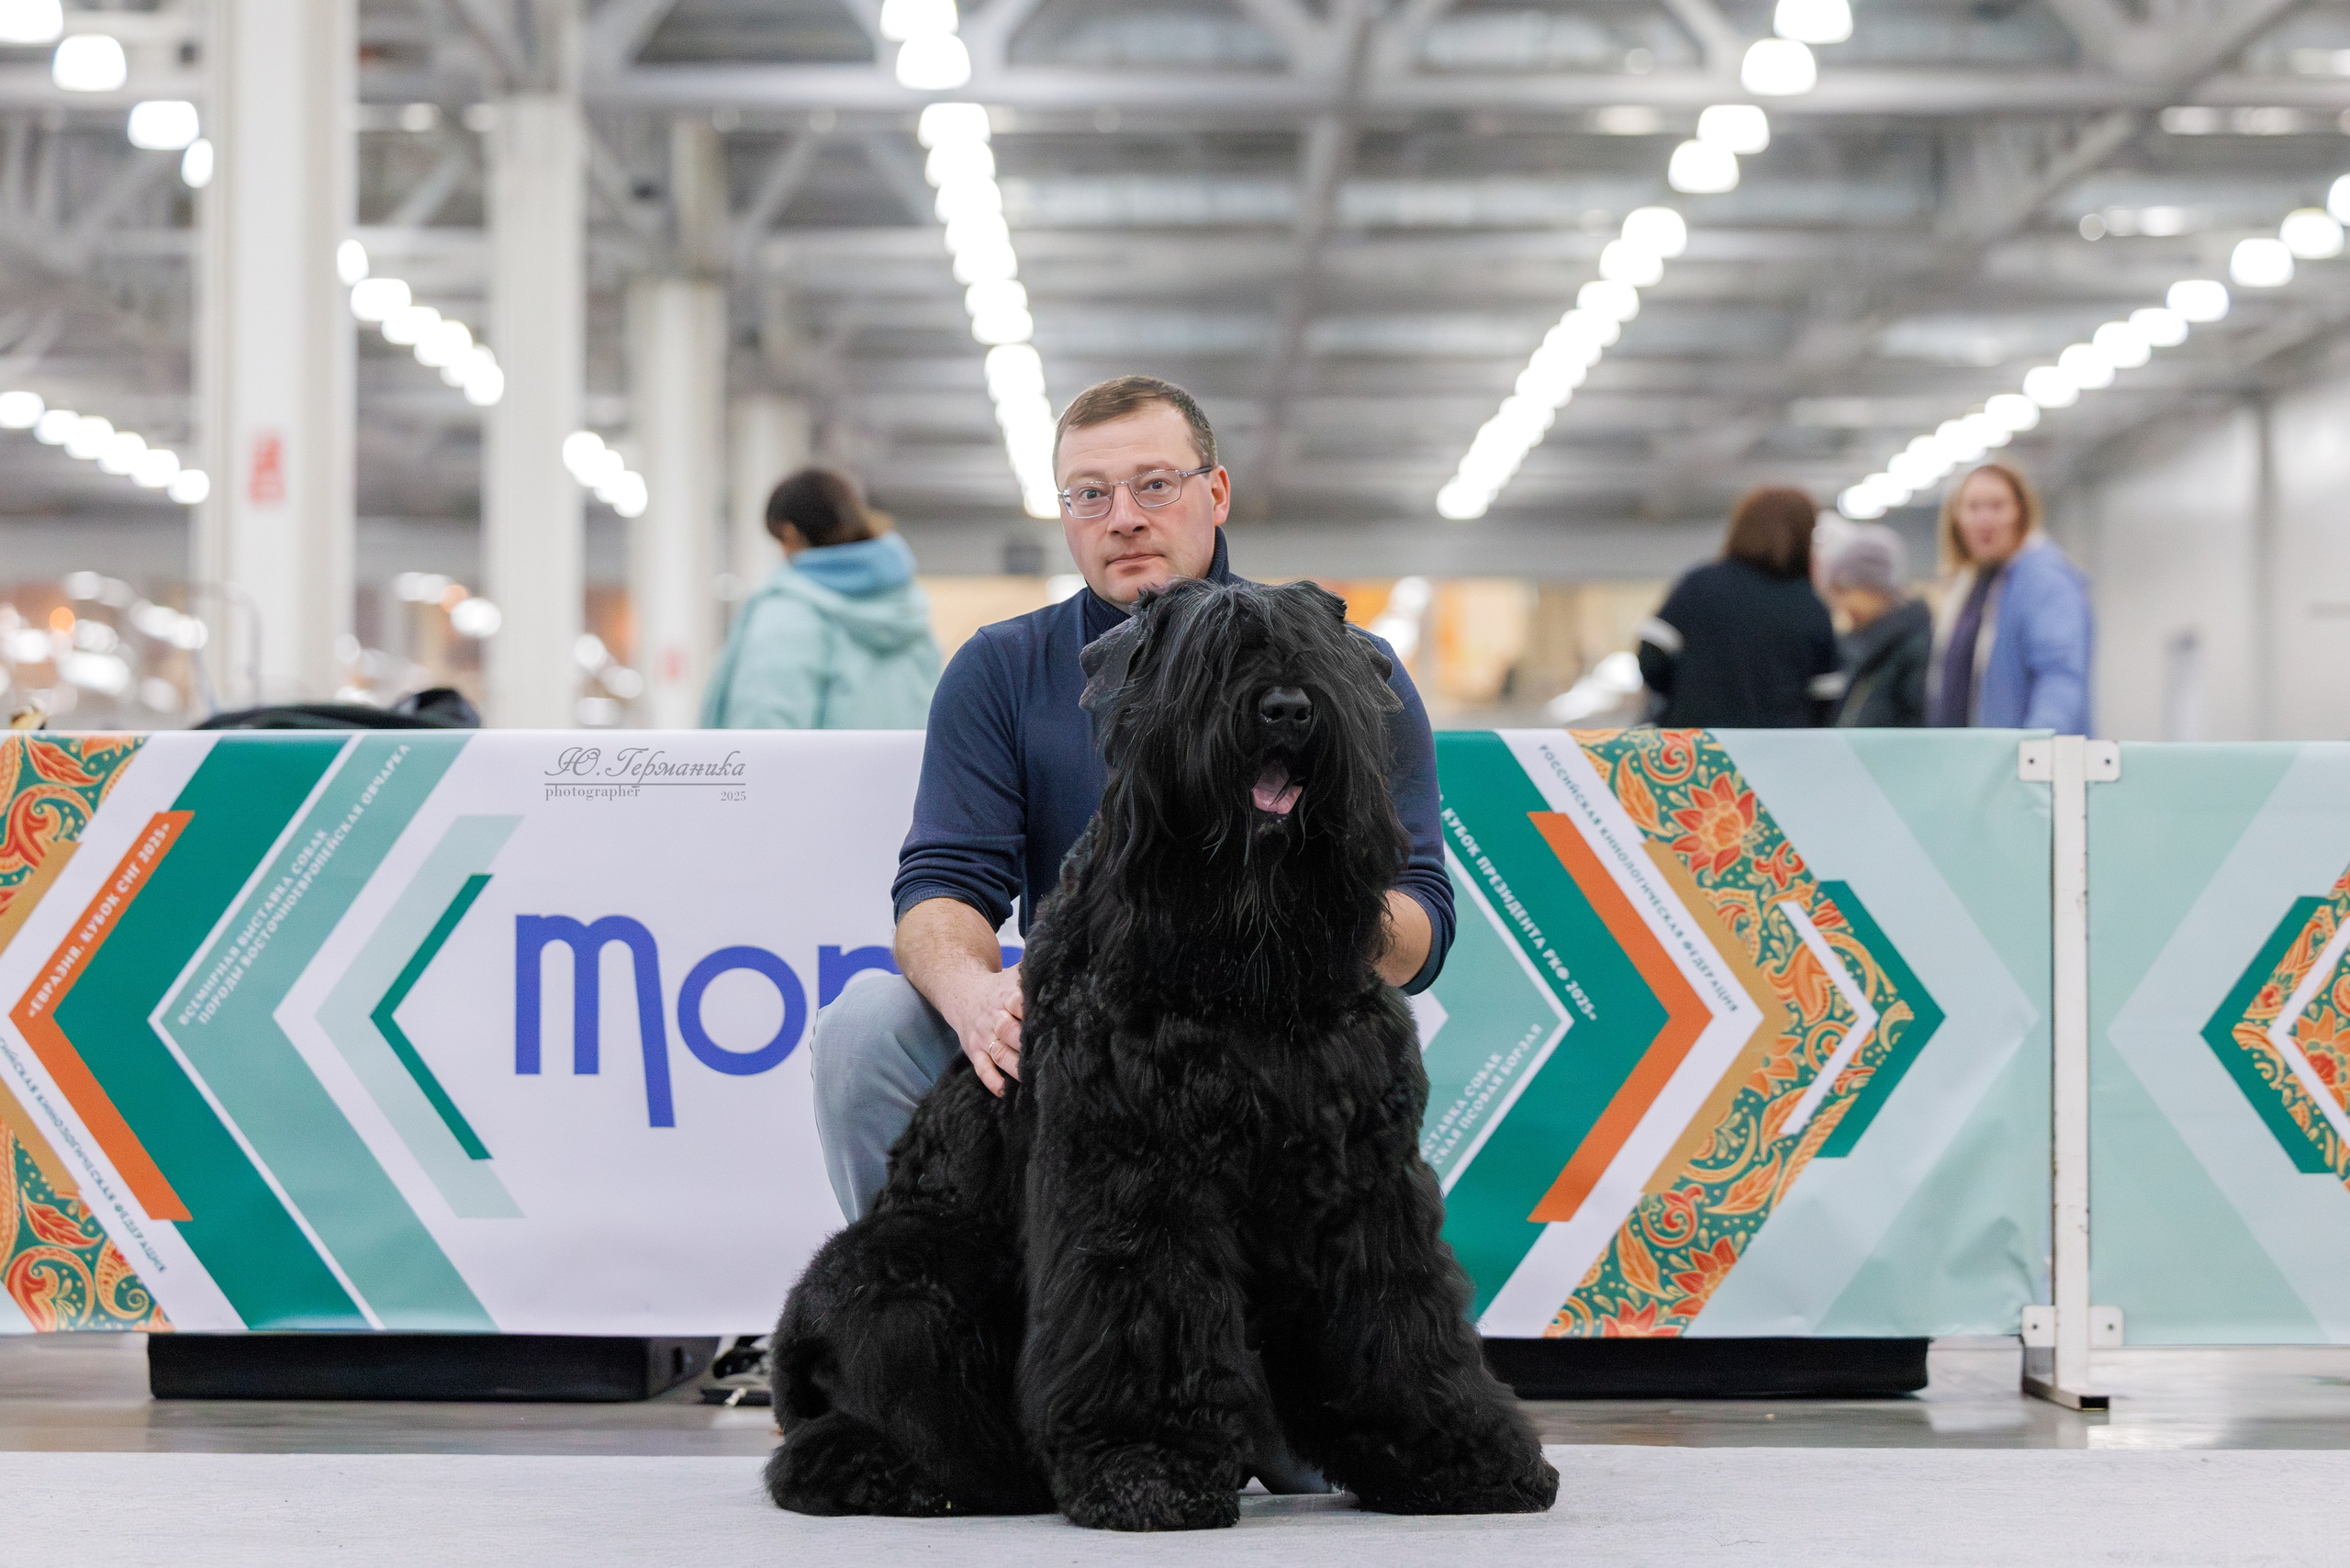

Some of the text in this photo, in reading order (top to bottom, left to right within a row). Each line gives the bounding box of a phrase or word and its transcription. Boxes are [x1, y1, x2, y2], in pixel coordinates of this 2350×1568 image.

[79, 892, 120, 943] КУБОК
[116, 861, 140, 893] СНГ
[178, 828, 328, 1026] ВСЕМИРНАЯ ВЫСТАВКА СОБАК
[197, 744, 411, 1025] ПОРОДЫ ВОСТОЧНОЕВРОПЕЙСКАЯ ОВЧАРКА
[1441, 807, 1482, 857] КУБОК
[1475, 856, 1547, 950] ПРЕЗИДЕНТА
[1542, 948, 1570, 980] РКФ
[1538, 744, 1738, 1012] РОССИЙСКАЯ КИНОЛОГИЧЕСКАЯ ФЕДЕРАЦИЯ
[1458, 1074, 1505, 1129] ПСОВАЯ
[1499, 1024, 1543, 1075] БОРЗАЯ
[1463, 1052, 1503, 1097] СОБАК
[35, 1093, 116, 1202] КИНОЛОГИЧЕСКАЯ
[114, 1203, 167, 1273] ФЕДЕРАЦИЯ
